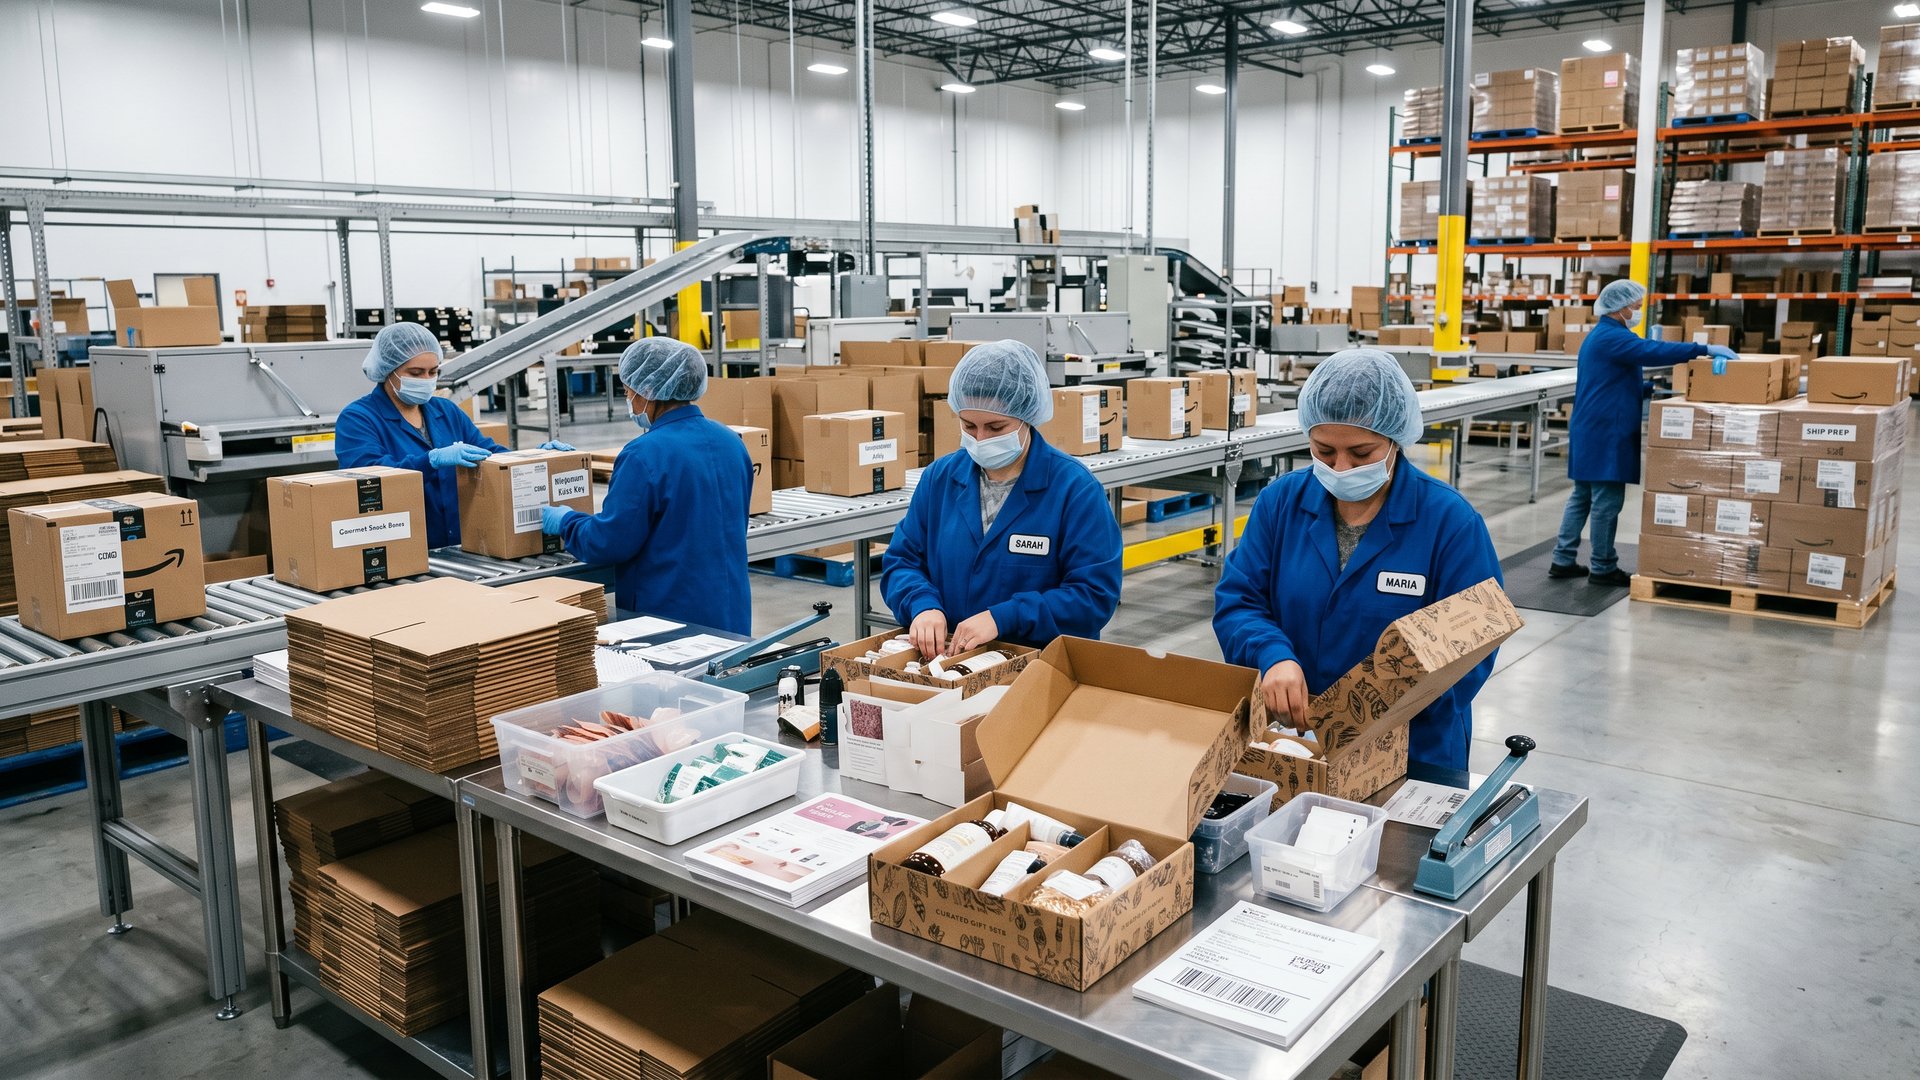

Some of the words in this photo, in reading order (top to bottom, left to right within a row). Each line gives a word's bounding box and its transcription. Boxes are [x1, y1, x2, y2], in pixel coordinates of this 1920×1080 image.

[1806, 427, 1826, 435] SHIP
[1827, 428, 1850, 436] PREP
[1015, 539, 1044, 550] SARAH
[1385, 577, 1418, 590] MARIA
[970, 920, 987, 930] GIFT
